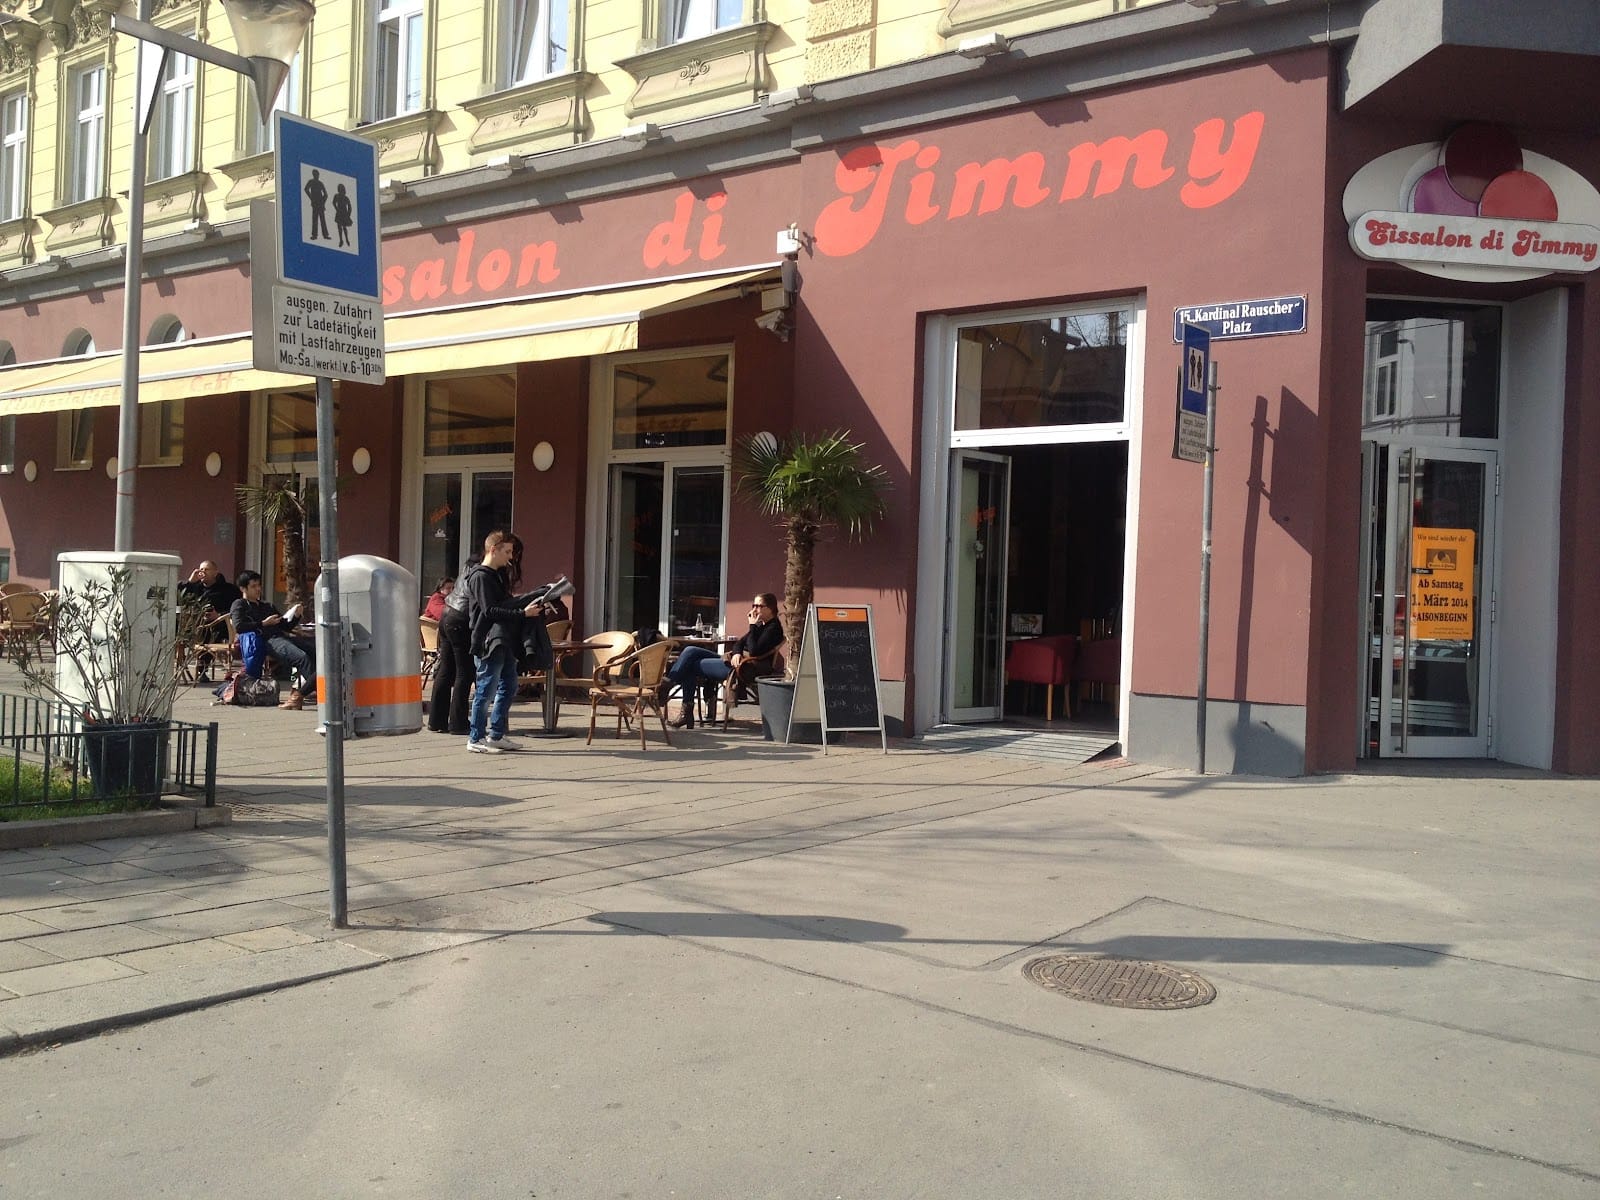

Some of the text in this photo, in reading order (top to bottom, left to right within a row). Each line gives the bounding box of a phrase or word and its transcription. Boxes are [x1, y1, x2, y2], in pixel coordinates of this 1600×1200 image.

[383, 111, 1265, 306] salon di Jimmy
[1365, 219, 1598, 262] Eissalon di Jimmy
[286, 296, 373, 321] ausgen. Zufahrt
[1195, 304, 1240, 322] Kardinal
[283, 314, 377, 340] zur Ladetätigkeit
[1222, 320, 1252, 335] Platz
[279, 331, 382, 360] mit Lastfahrzeugen
[1418, 578, 1464, 592] Ab Samstag
[1423, 593, 1449, 607] März
[1451, 597, 1468, 608] 2014
